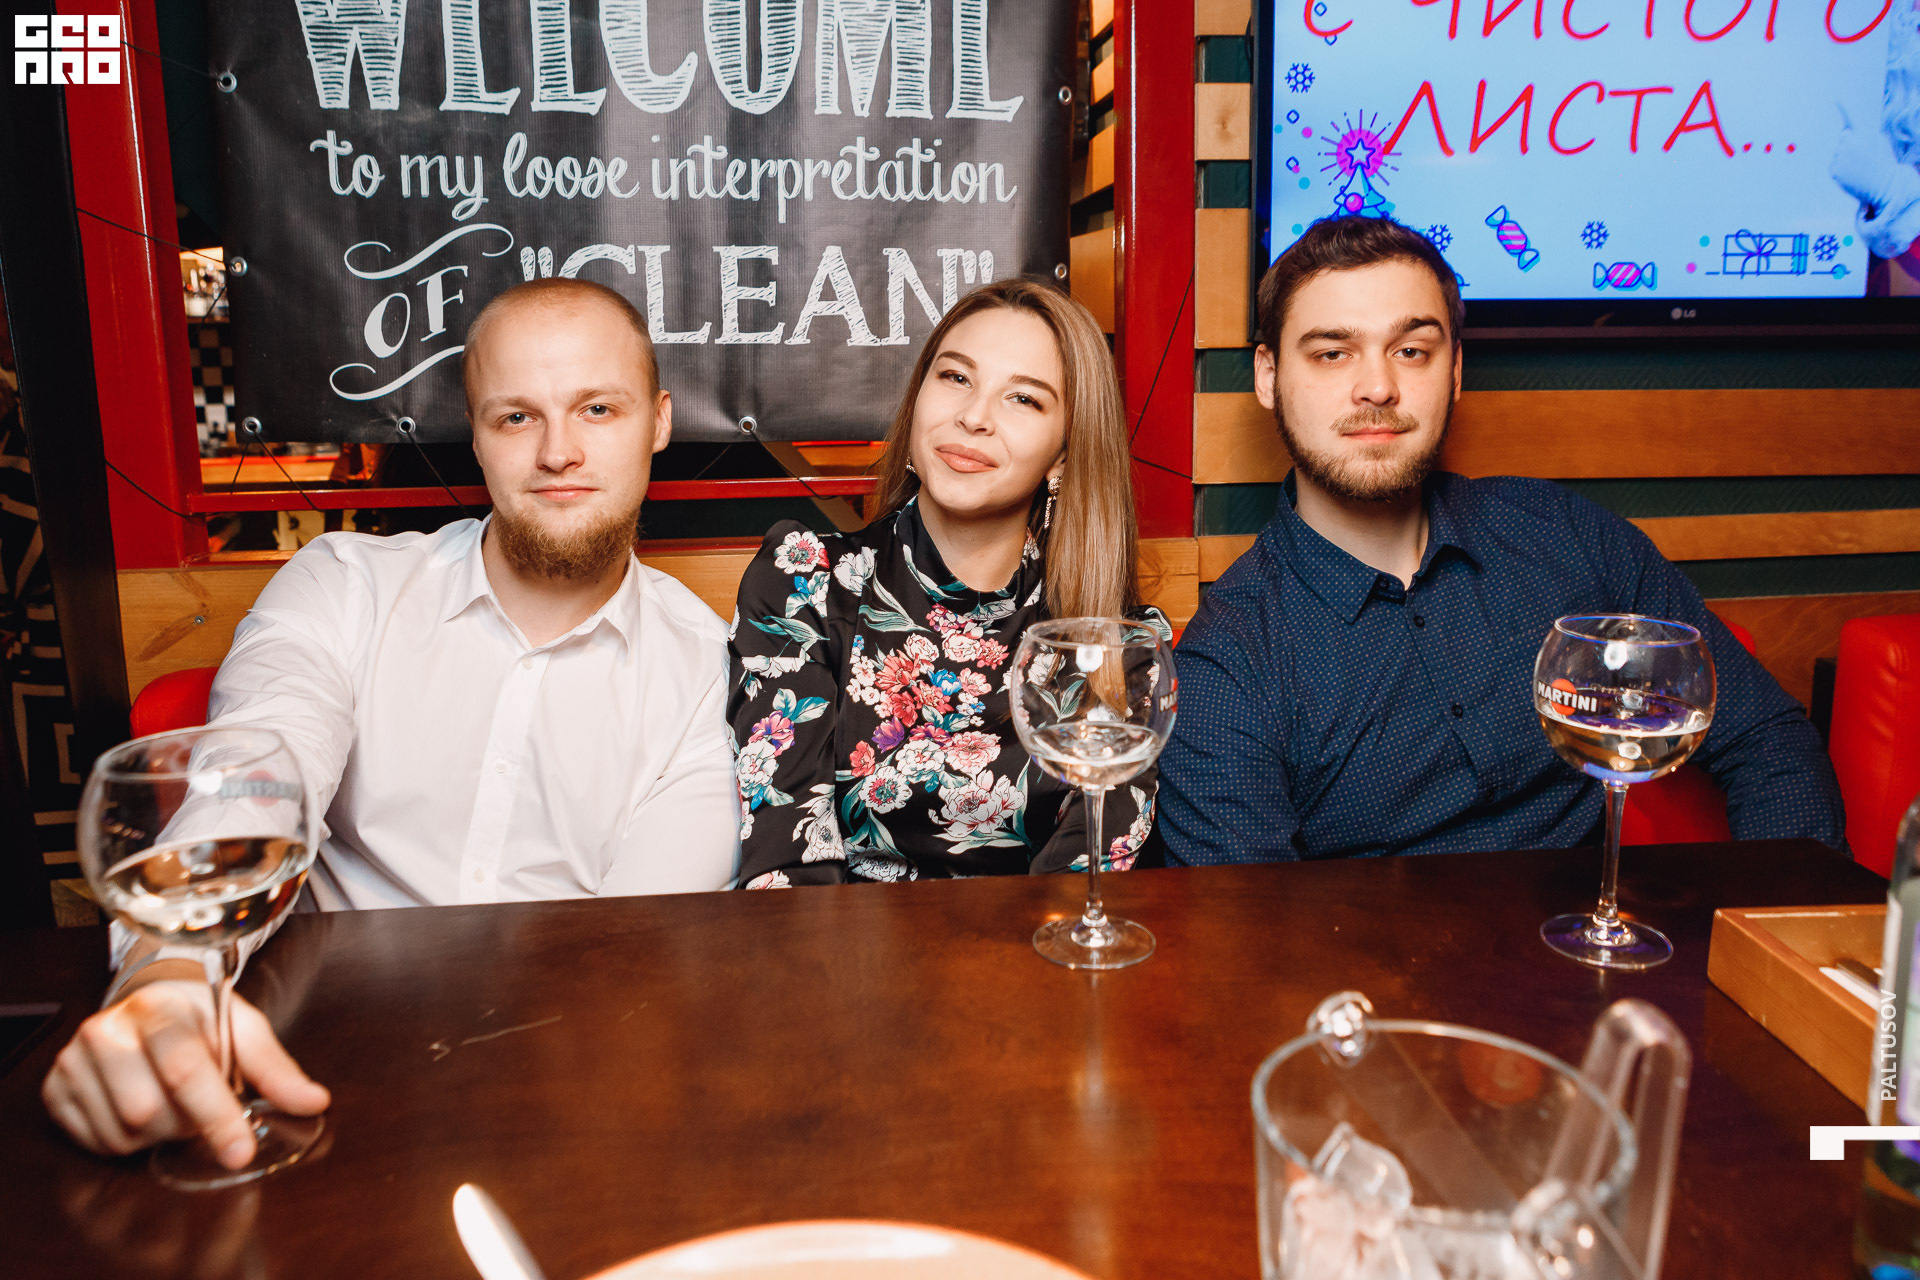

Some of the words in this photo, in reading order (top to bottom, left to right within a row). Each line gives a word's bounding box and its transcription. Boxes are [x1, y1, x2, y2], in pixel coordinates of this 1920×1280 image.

[1383, 80, 1797, 157] ЛИСТА...
[310, 130, 385, 197] to
[400, 154, 489, 221] my
[503, 132, 640, 199] loose
[652, 135, 1017, 223] interpretation
[364, 265, 470, 358] OF
[1538, 682, 1597, 712] MARTINI
